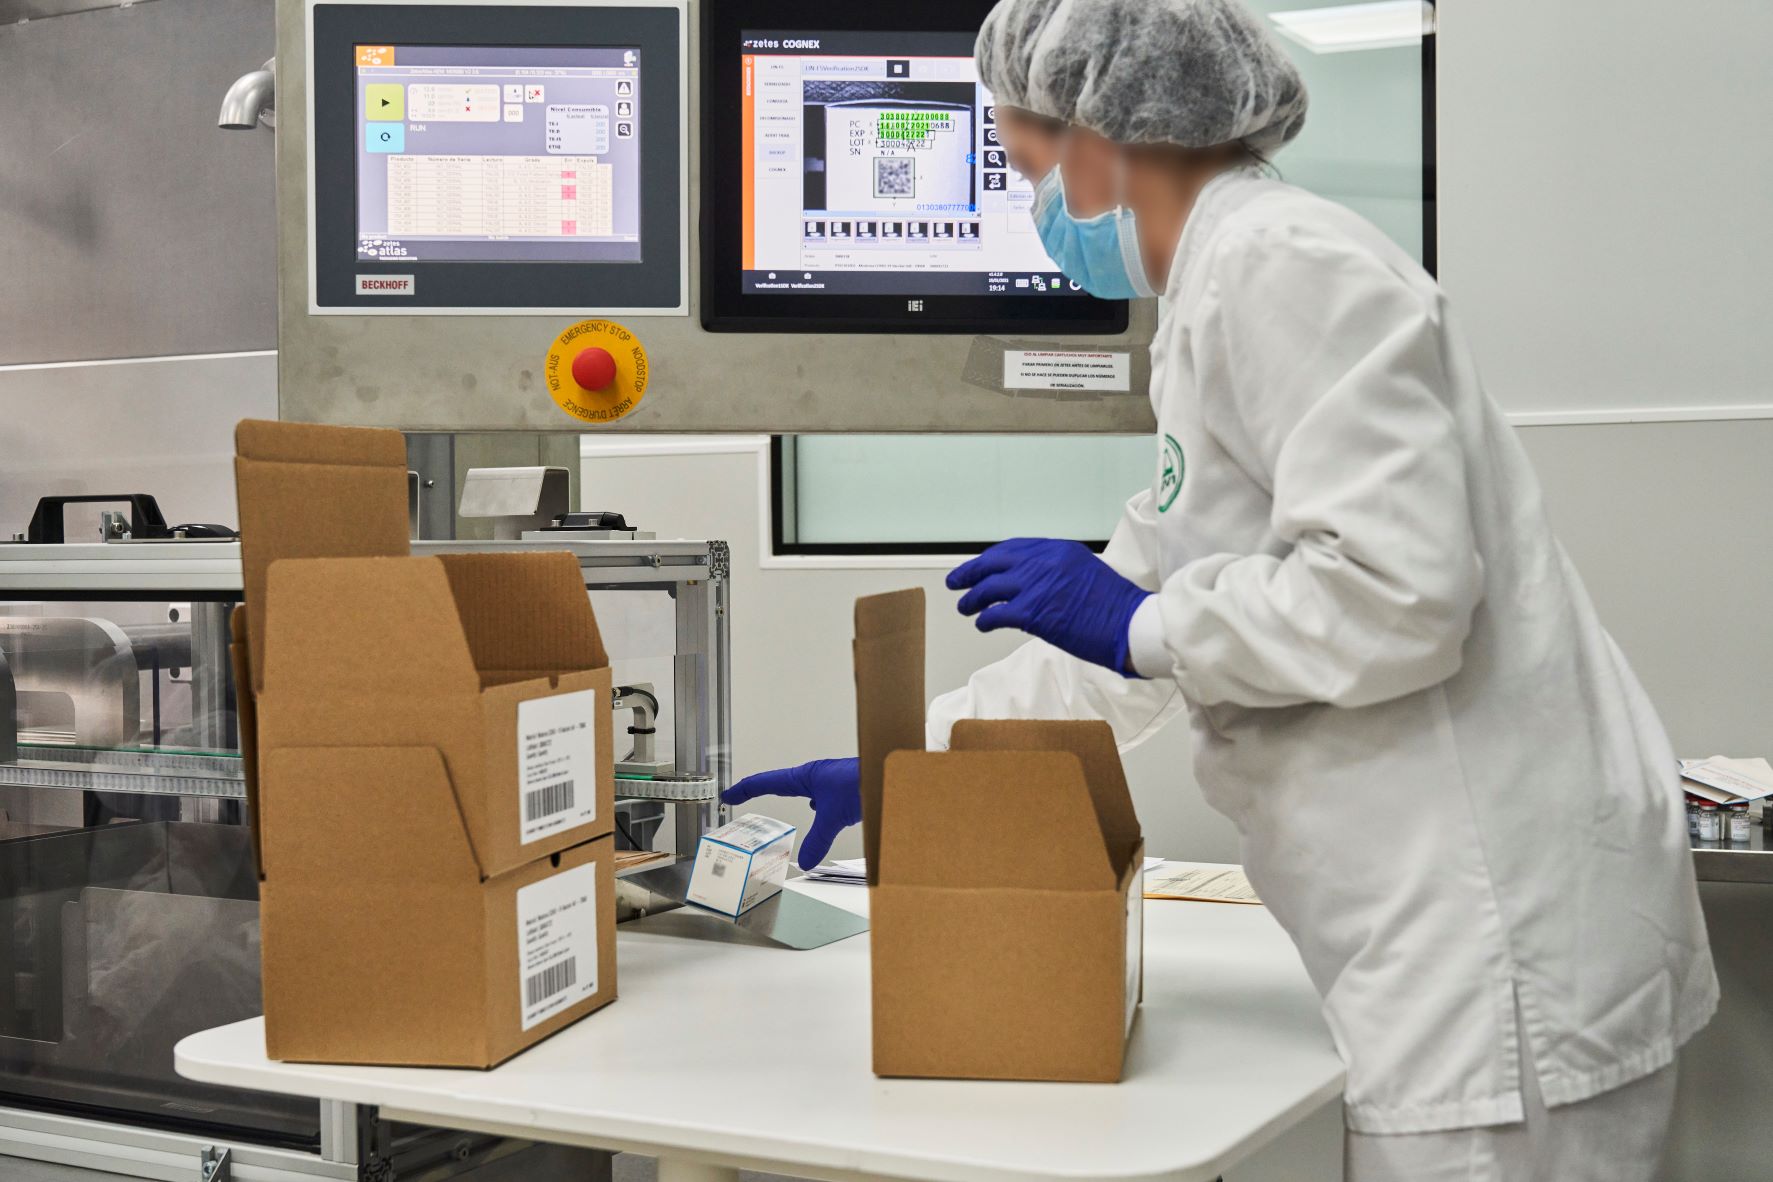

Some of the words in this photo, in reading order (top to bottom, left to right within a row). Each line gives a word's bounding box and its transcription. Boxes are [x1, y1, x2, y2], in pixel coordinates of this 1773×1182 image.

[752, 38, 779, 49] zetes
[782, 39, 820, 49] COGNEX
[409, 124, 427, 132] RUN
[849, 120, 861, 128] PC
[849, 129, 865, 138] EXP
[849, 139, 864, 147] LOT
[849, 148, 861, 156] SN
[379, 245, 408, 256] atlas
[361, 280, 409, 290] BECKHOFF
[560, 322, 609, 345] EMERGENCY
[609, 325, 631, 342] STOP
[548, 354, 561, 391] NOT-AUS
[631, 346, 646, 393] NOODSTOP
